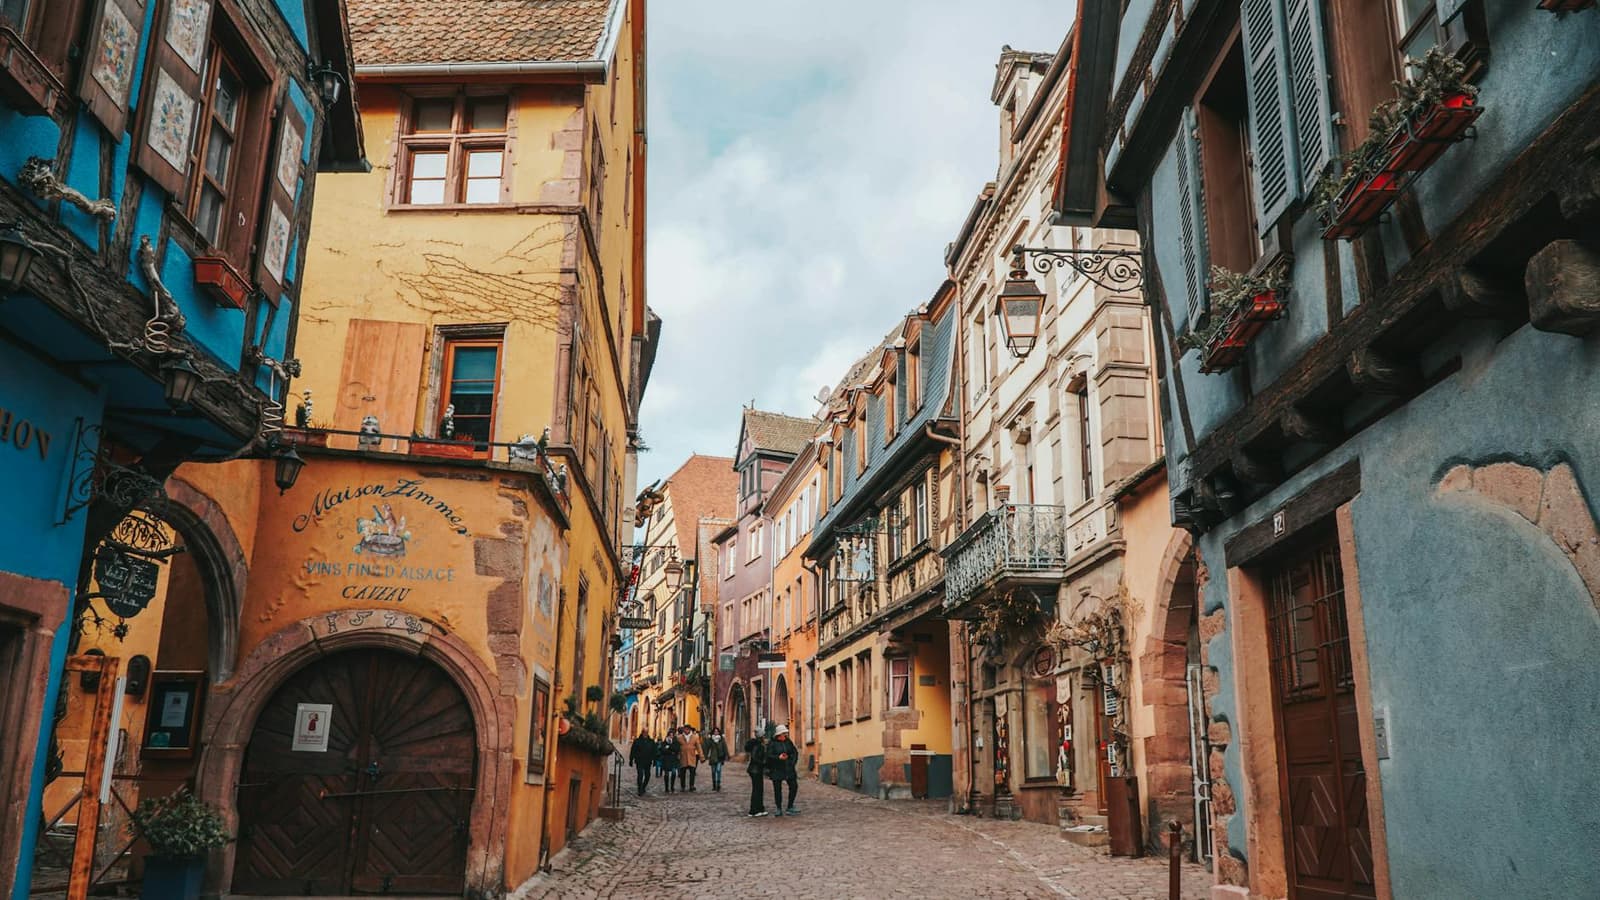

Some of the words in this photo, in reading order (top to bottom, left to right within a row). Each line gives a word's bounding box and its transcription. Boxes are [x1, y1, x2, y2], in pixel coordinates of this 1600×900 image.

[292, 484, 385, 532] Maison
[382, 479, 472, 537] Zimmer
[306, 561, 342, 577] VINS
[347, 562, 383, 577] FINS
[341, 585, 412, 602] CAVEAU
